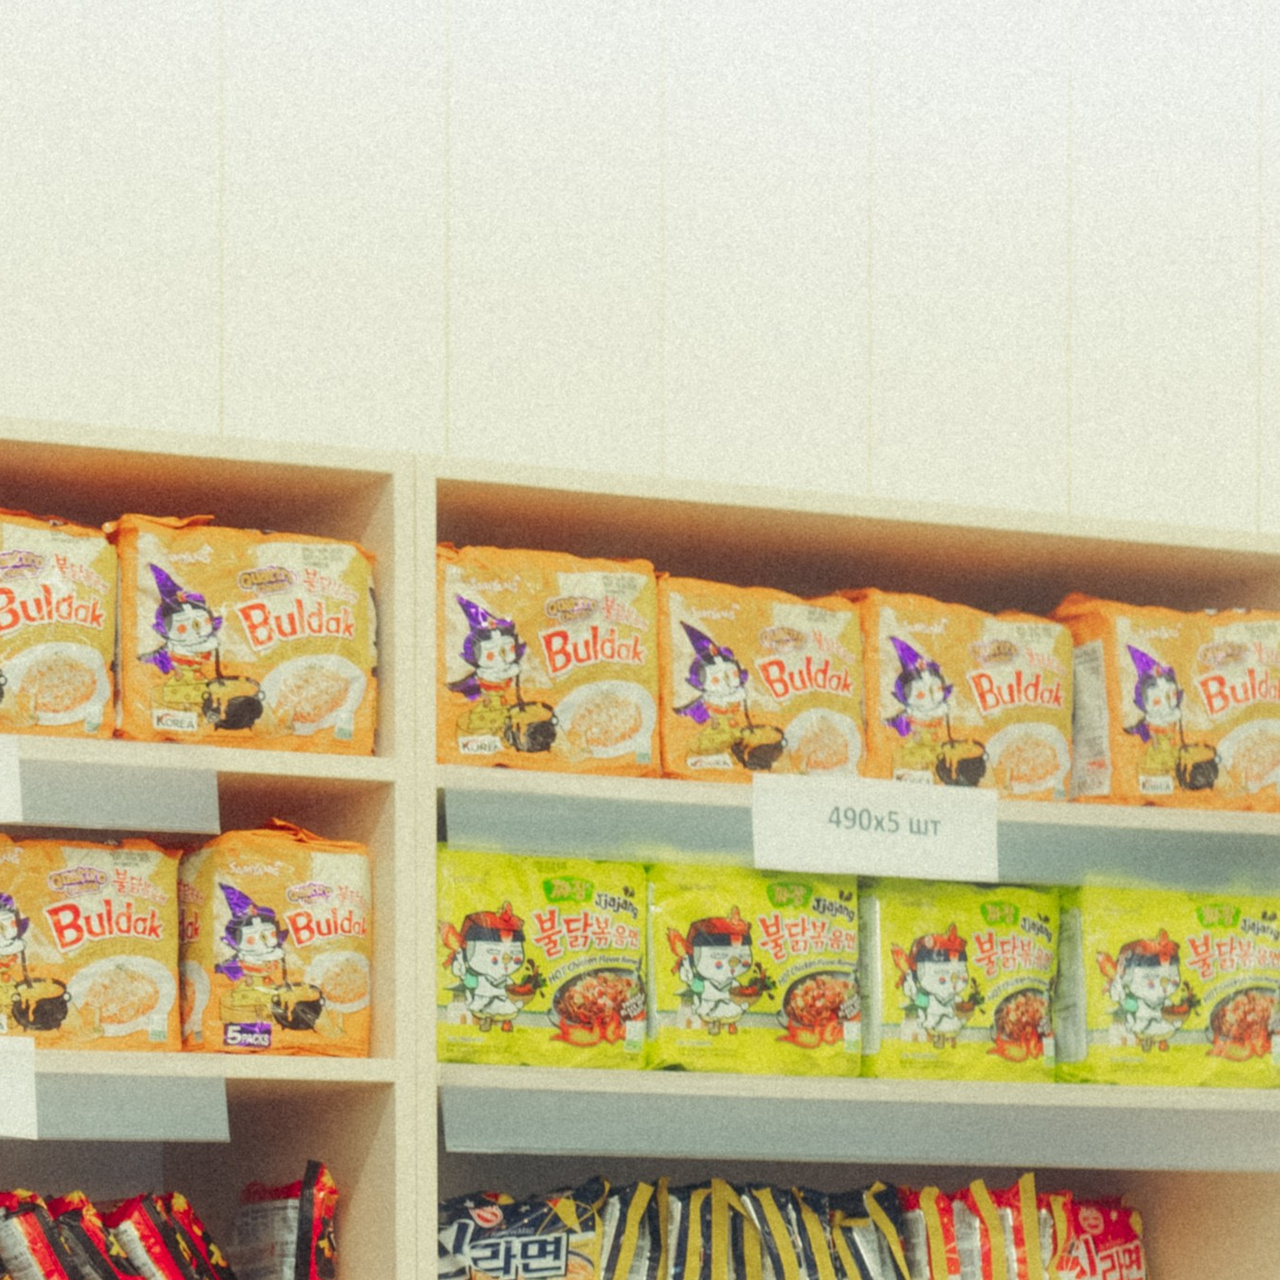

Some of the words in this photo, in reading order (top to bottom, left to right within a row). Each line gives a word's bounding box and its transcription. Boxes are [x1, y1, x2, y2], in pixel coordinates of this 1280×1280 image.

[238, 599, 355, 648] Buldak
[542, 625, 645, 674] Buldak
[759, 656, 853, 699] Buldak
[971, 669, 1064, 712] Buldak
[156, 713, 195, 730] KOREA
[909, 818, 941, 837] шт
[45, 899, 164, 951] Buldak
[595, 892, 639, 920] Jjajang
[812, 897, 856, 923] Jjajang
[533, 908, 640, 959] 불닭볶음면
[759, 913, 856, 962] 불닭볶음면
[548, 967, 566, 984] HOT
